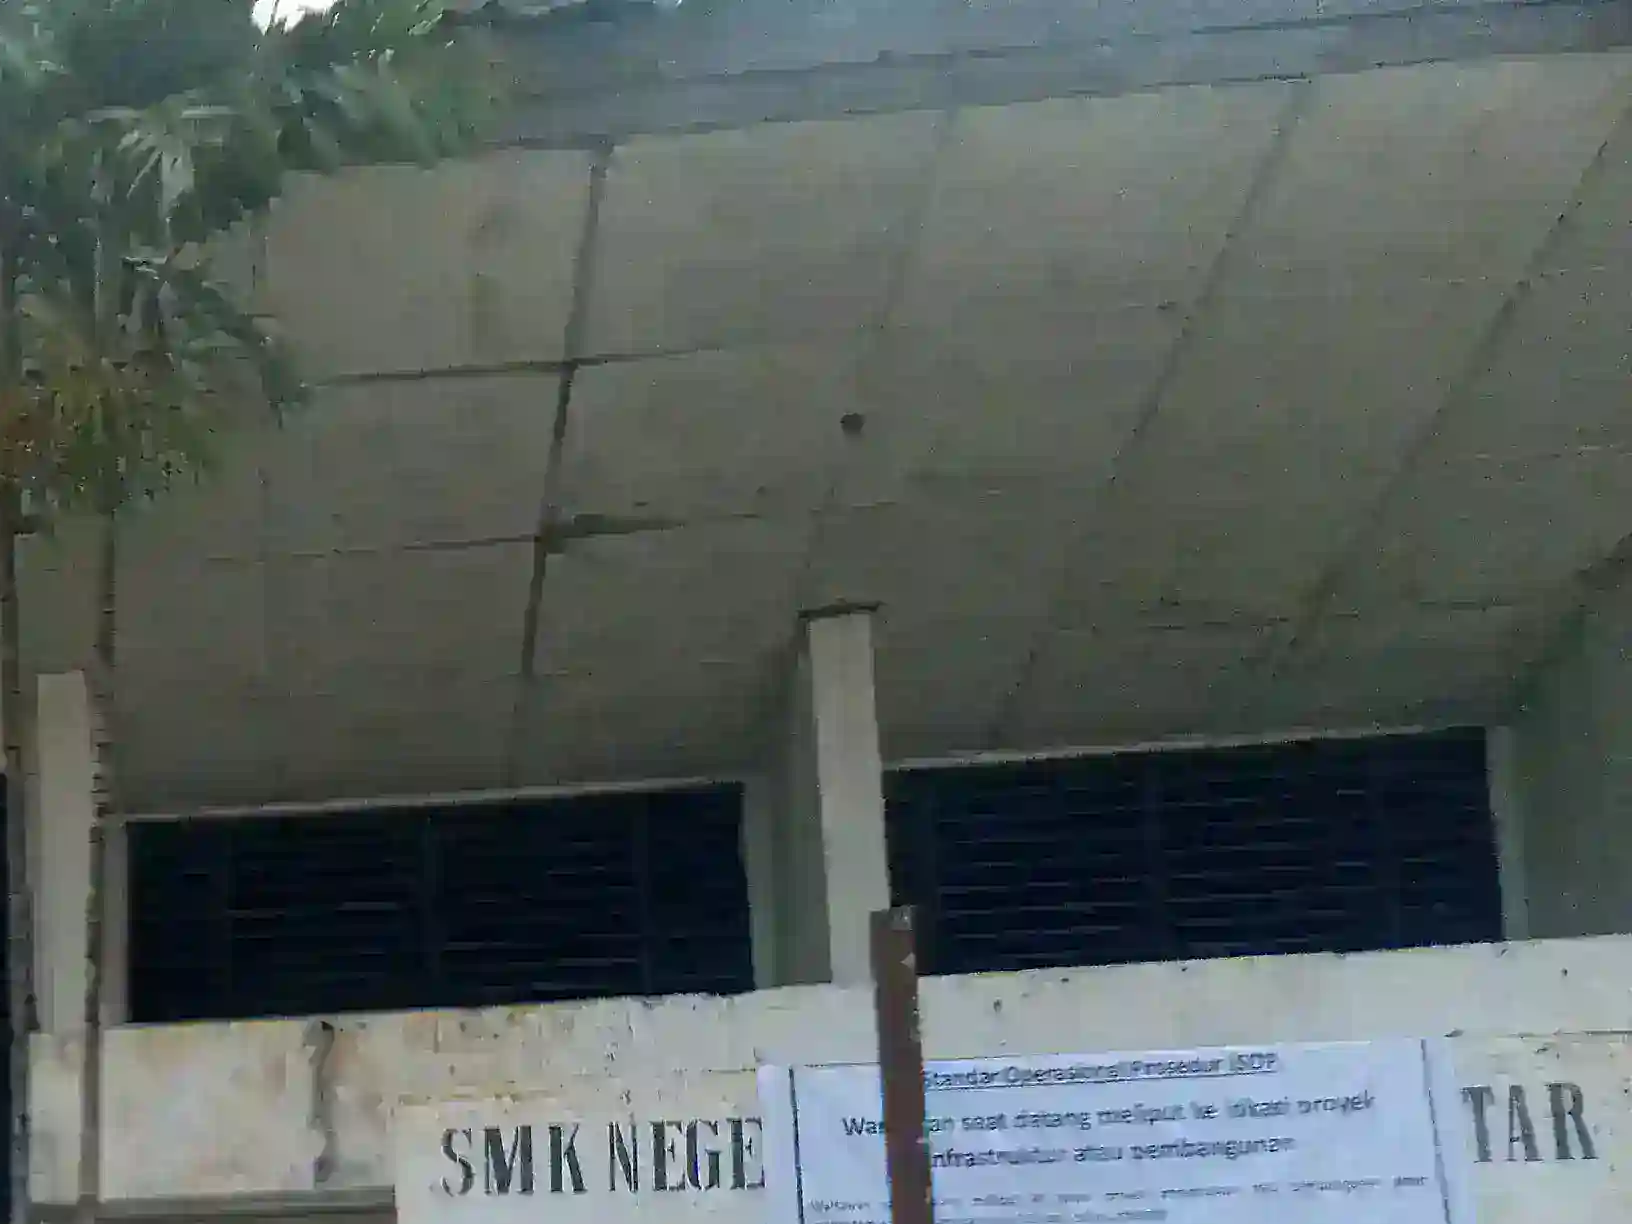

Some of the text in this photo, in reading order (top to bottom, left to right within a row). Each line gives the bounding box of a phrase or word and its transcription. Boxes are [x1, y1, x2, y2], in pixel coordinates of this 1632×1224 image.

[1013, 1107, 1092, 1131] datang
[1296, 1089, 1376, 1116] proyek
[439, 1124, 587, 1197] SMK
